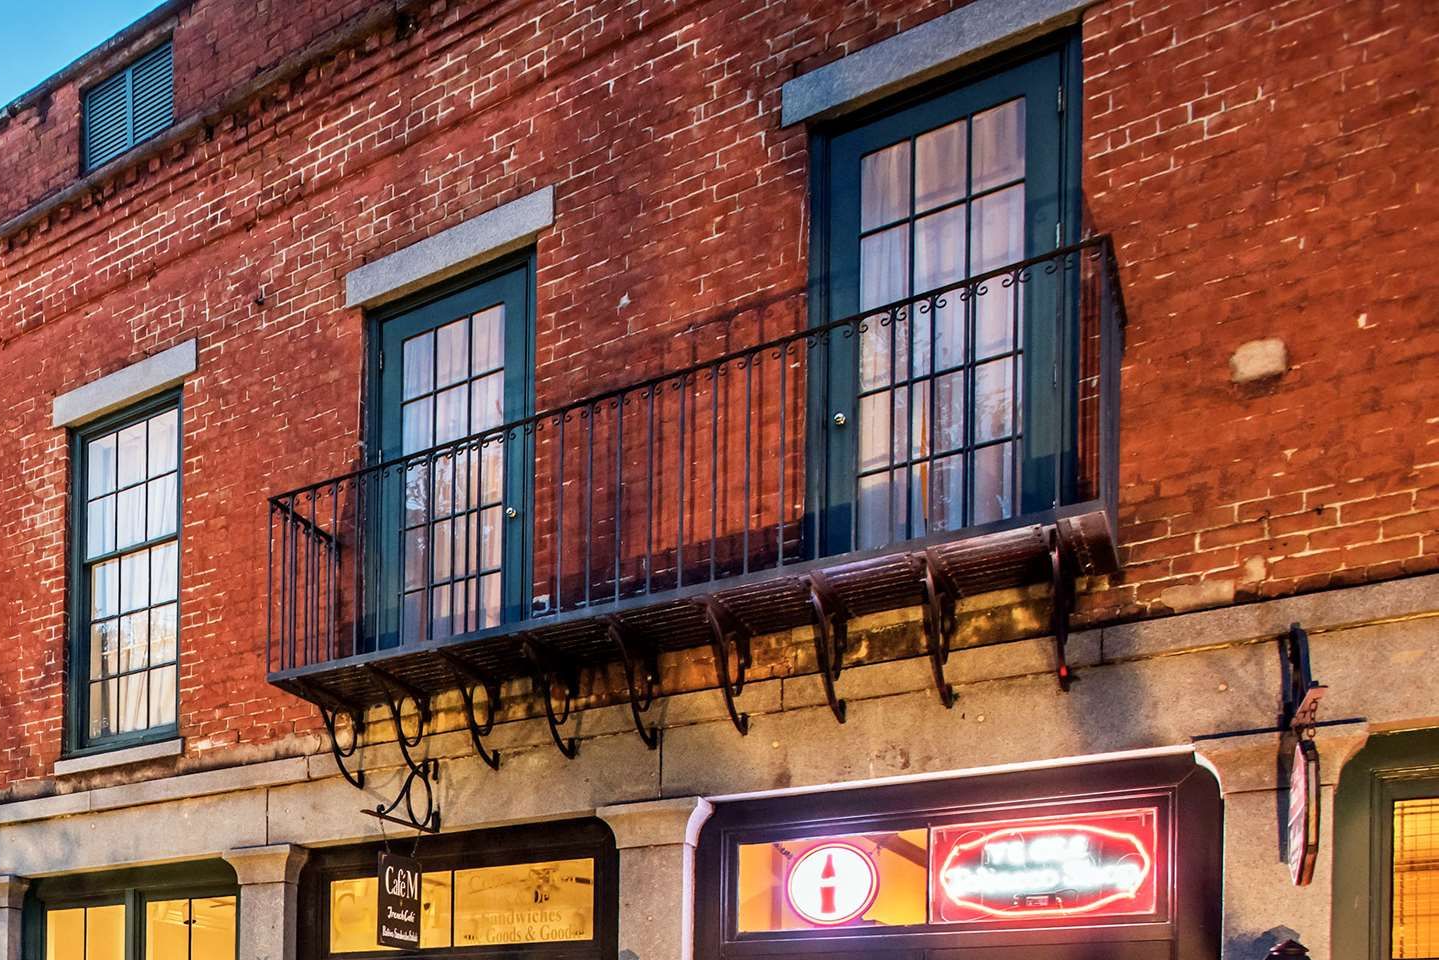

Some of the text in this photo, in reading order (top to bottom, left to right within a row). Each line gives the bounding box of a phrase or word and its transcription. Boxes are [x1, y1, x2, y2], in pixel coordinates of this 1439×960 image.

[385, 865, 419, 900] Café M
[482, 909, 562, 926] Sandwiches
[485, 928, 522, 943] Goods
[524, 926, 537, 941] &
